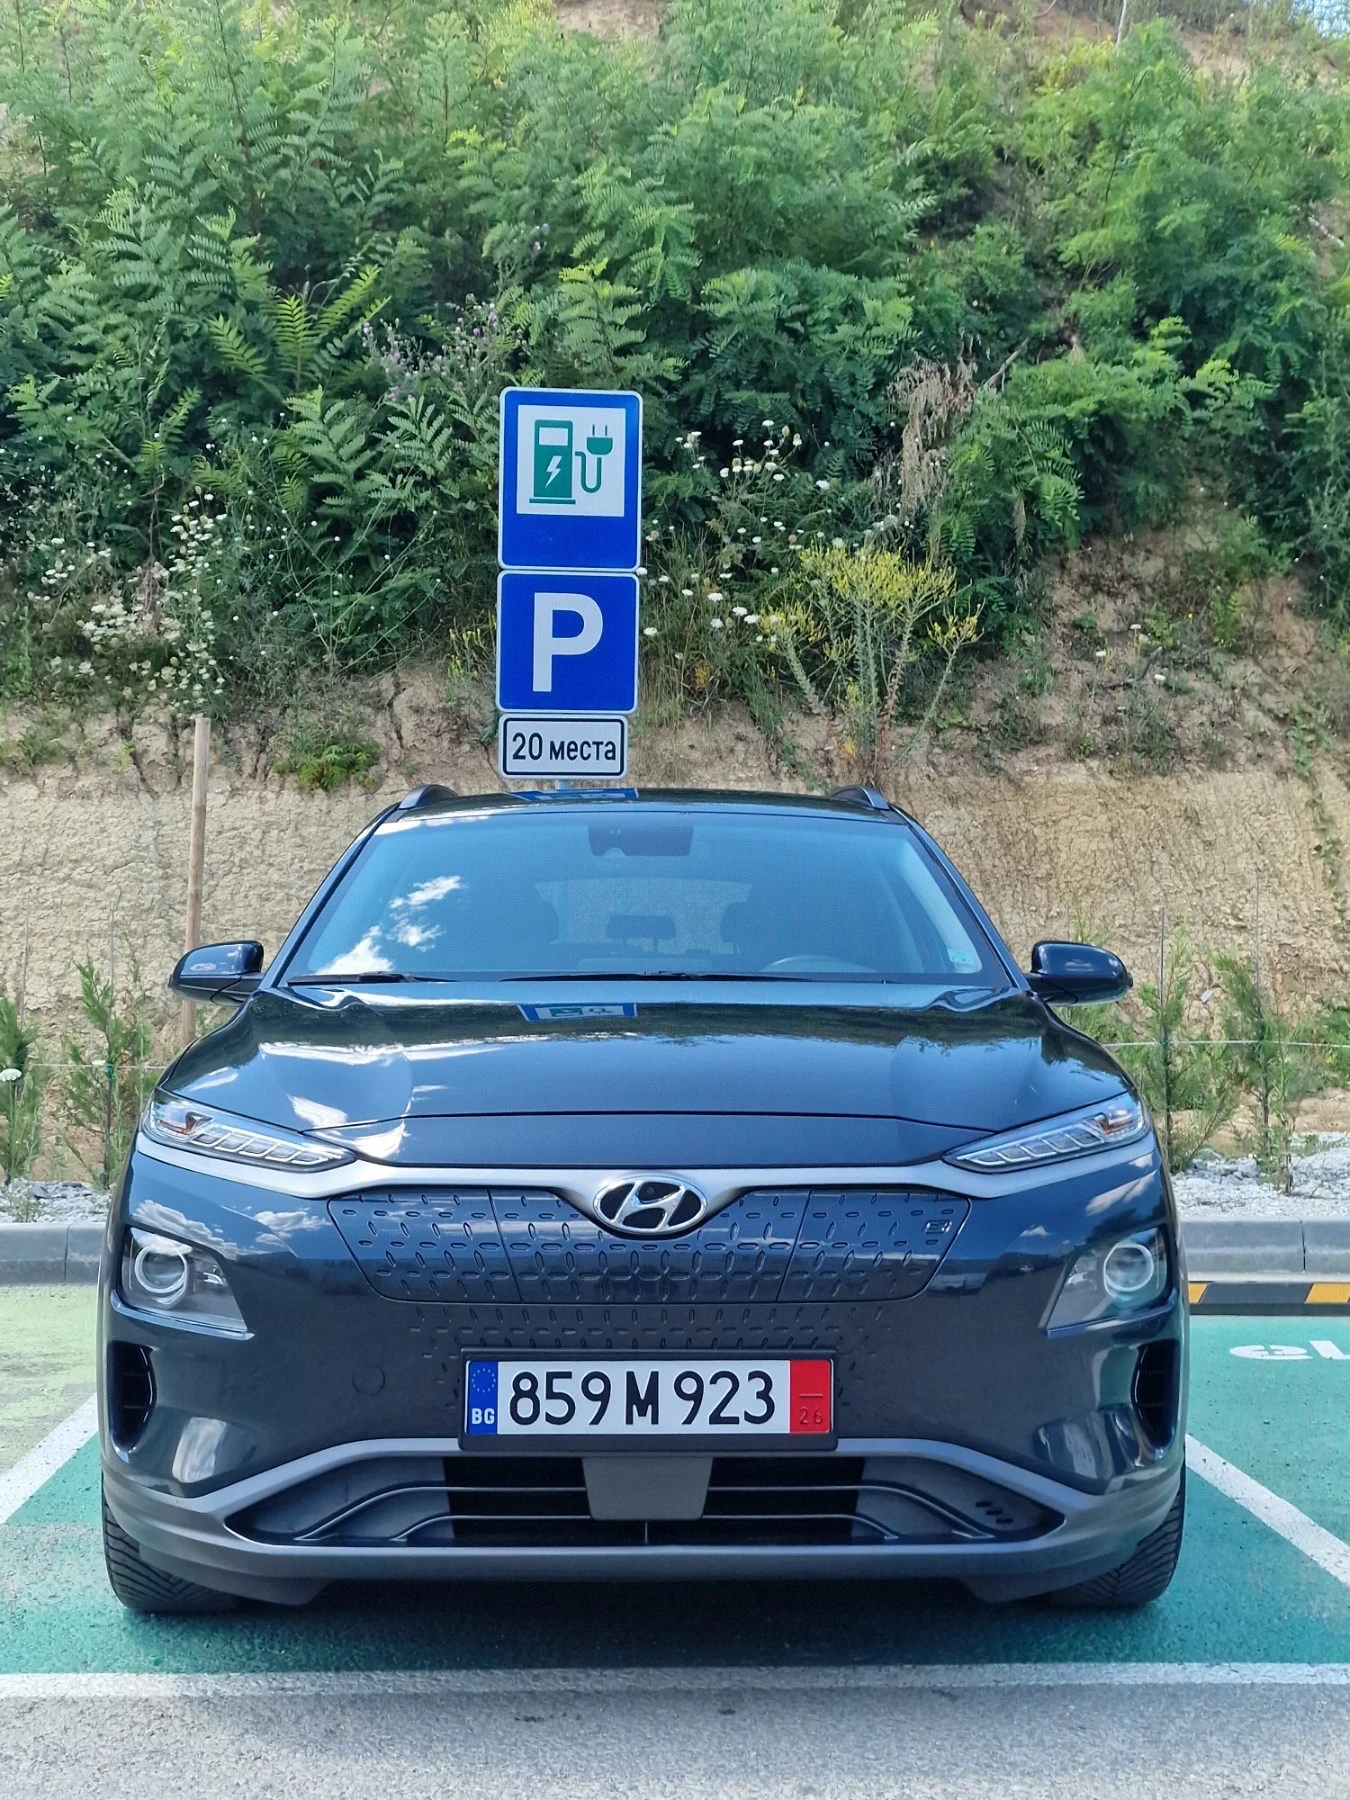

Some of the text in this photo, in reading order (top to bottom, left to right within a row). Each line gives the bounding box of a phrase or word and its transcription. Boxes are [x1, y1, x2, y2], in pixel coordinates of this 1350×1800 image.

[532, 592, 604, 692] P
[512, 732, 617, 761] 20 места
[509, 1371, 612, 1426] 859
[673, 1370, 776, 1425] 923
[471, 1407, 495, 1425] BG
[799, 1406, 823, 1425] 26
